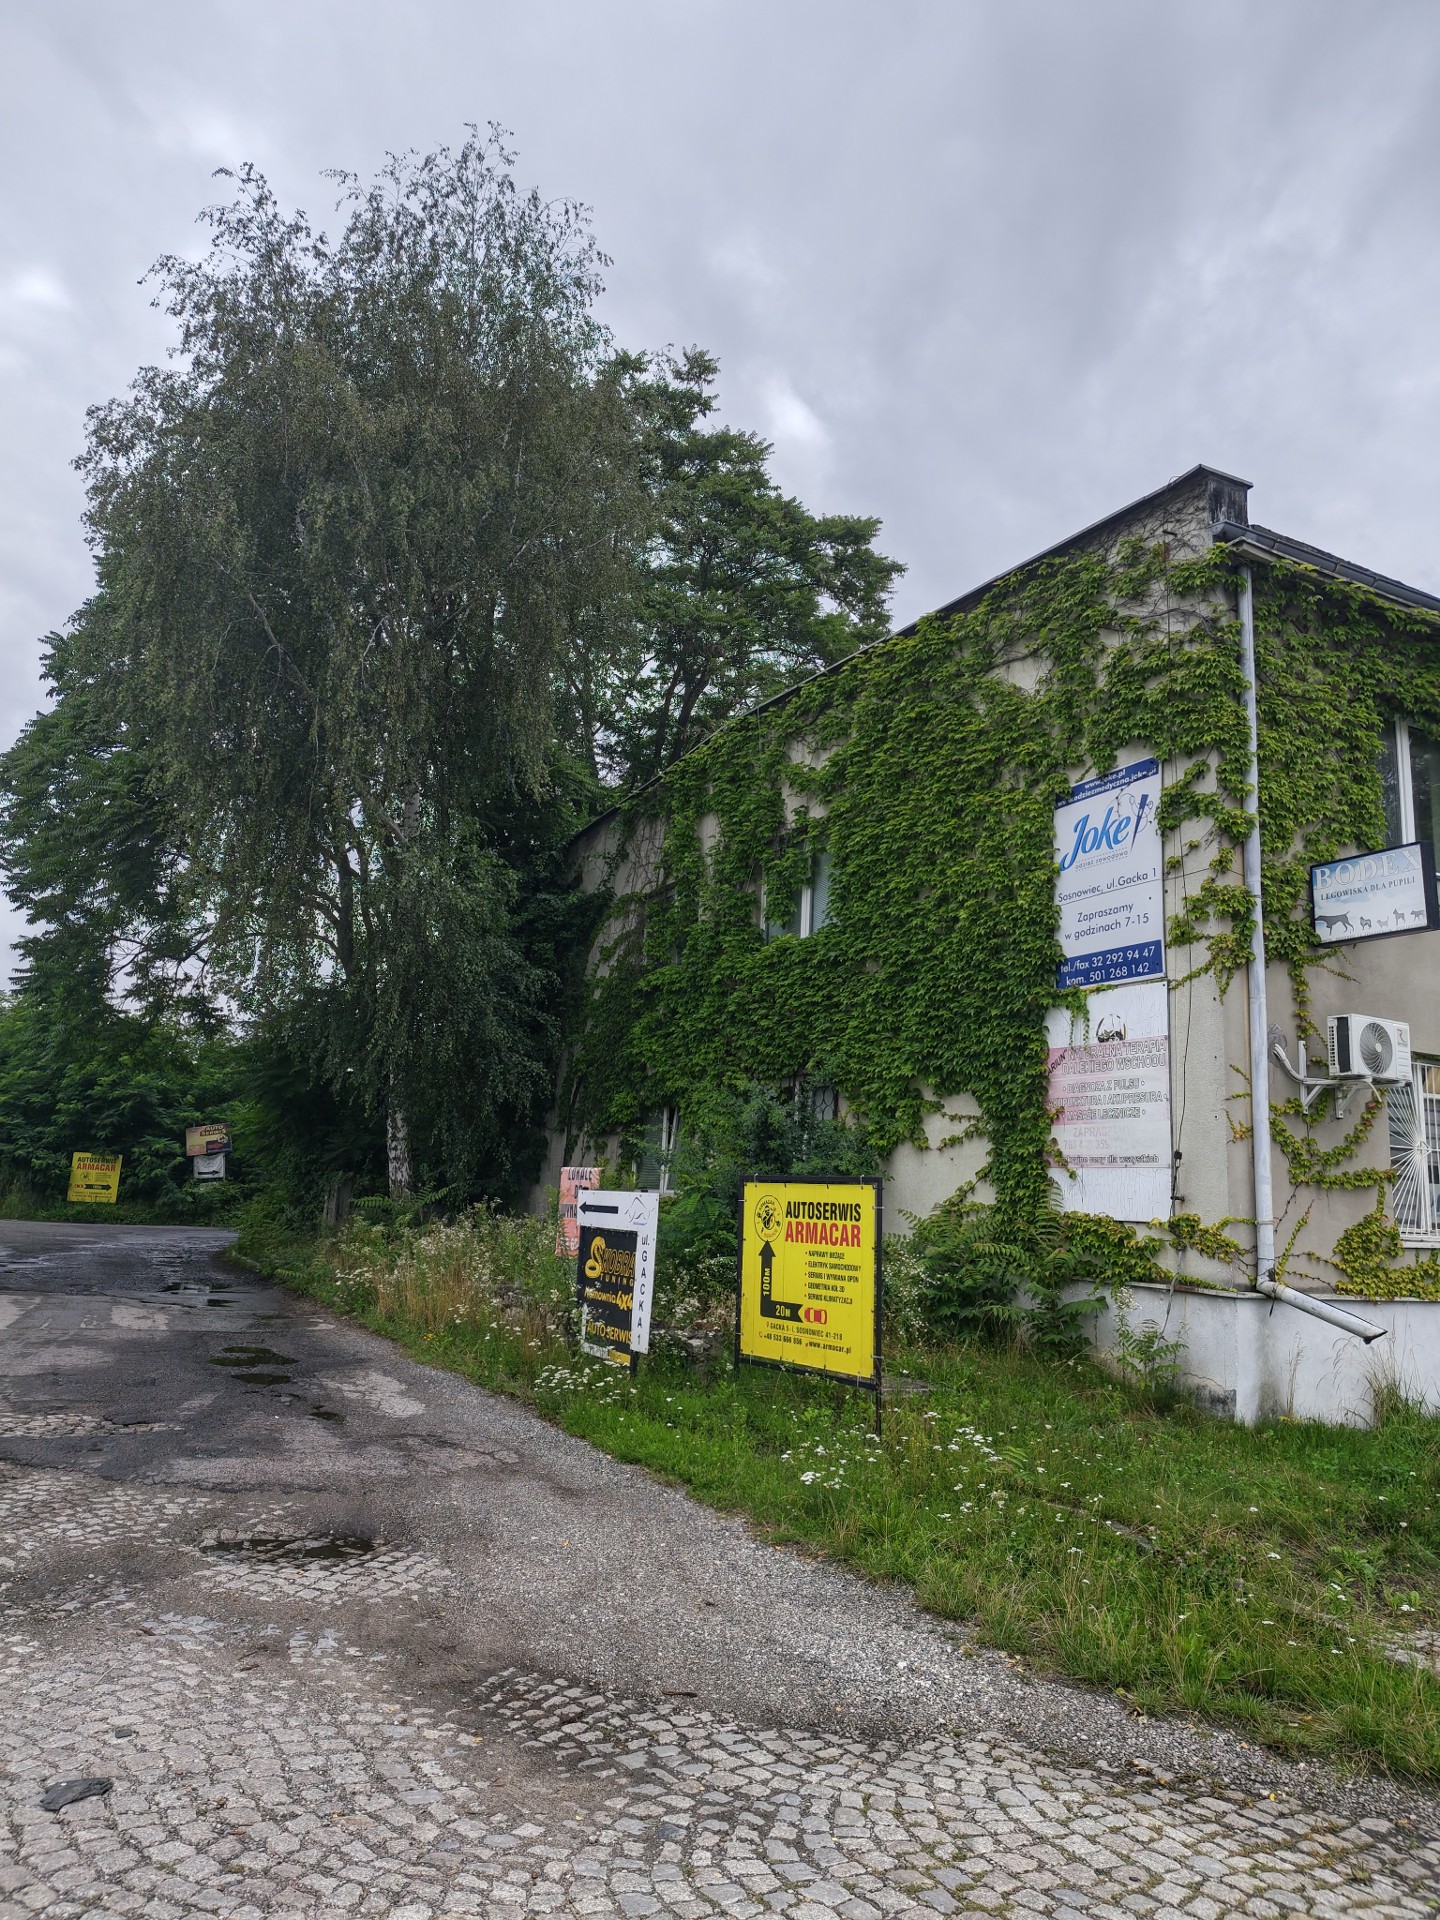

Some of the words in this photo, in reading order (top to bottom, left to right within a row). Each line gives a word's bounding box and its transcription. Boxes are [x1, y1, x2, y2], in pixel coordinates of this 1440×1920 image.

[1060, 806, 1131, 871] Joke
[1314, 848, 1421, 890] BODEX
[1058, 885, 1103, 902] Sosnowiec,
[1153, 868, 1156, 878] 1
[1320, 886, 1368, 901] LEGOWISKA
[1370, 882, 1387, 892] DLA
[1388, 877, 1415, 888] PUPILI
[1077, 903, 1134, 922] Zapraszamy
[1074, 919, 1121, 940] godzinach
[1125, 913, 1149, 928] 7-15
[1060, 960, 1089, 973] tel./fax
[1092, 957, 1103, 967] 32
[1106, 952, 1124, 964] 292
[1126, 950, 1139, 960] 94
[1142, 946, 1155, 957] 47
[1066, 976, 1086, 986] kom.
[1090, 970, 1106, 982] 501
[1110, 966, 1128, 978] 268
[1132, 962, 1150, 974] 142
[1124, 1038, 1166, 1056] TERAPIA
[1062, 1060, 1114, 1076] DALEKIEGO
[1117, 1053, 1166, 1070] WSCHODU
[1114, 1078, 1140, 1090] PULSU
[1098, 1107, 1140, 1120] LECZNICZE
[76, 1162, 116, 1172] ARMACAR
[786, 1201, 862, 1222] AUTOSERWIS
[641, 1234, 650, 1246] ul.
[784, 1221, 861, 1248] ARMACAR
[808, 1250, 828, 1258] NAPRAWY
[808, 1260, 828, 1269] ELEKTRYK
[829, 1262, 861, 1272] SAMOCHODOWY
[600, 1274, 634, 1287] TUNING
[808, 1272, 823, 1280] SERWIS
[826, 1274, 846, 1282] WYMIANA
[638, 1250, 648, 1328] GACKA
[808, 1282, 830, 1290] GEOMETRIA
[808, 1293, 822, 1301] SERWIS
[637, 1334, 641, 1345] 1
[770, 1323, 786, 1331] GACKA
[796, 1326, 824, 1338] SOSNOWIEC
[825, 1332, 843, 1340] 41-218
[809, 1341, 852, 1355] www.armacar.pl
